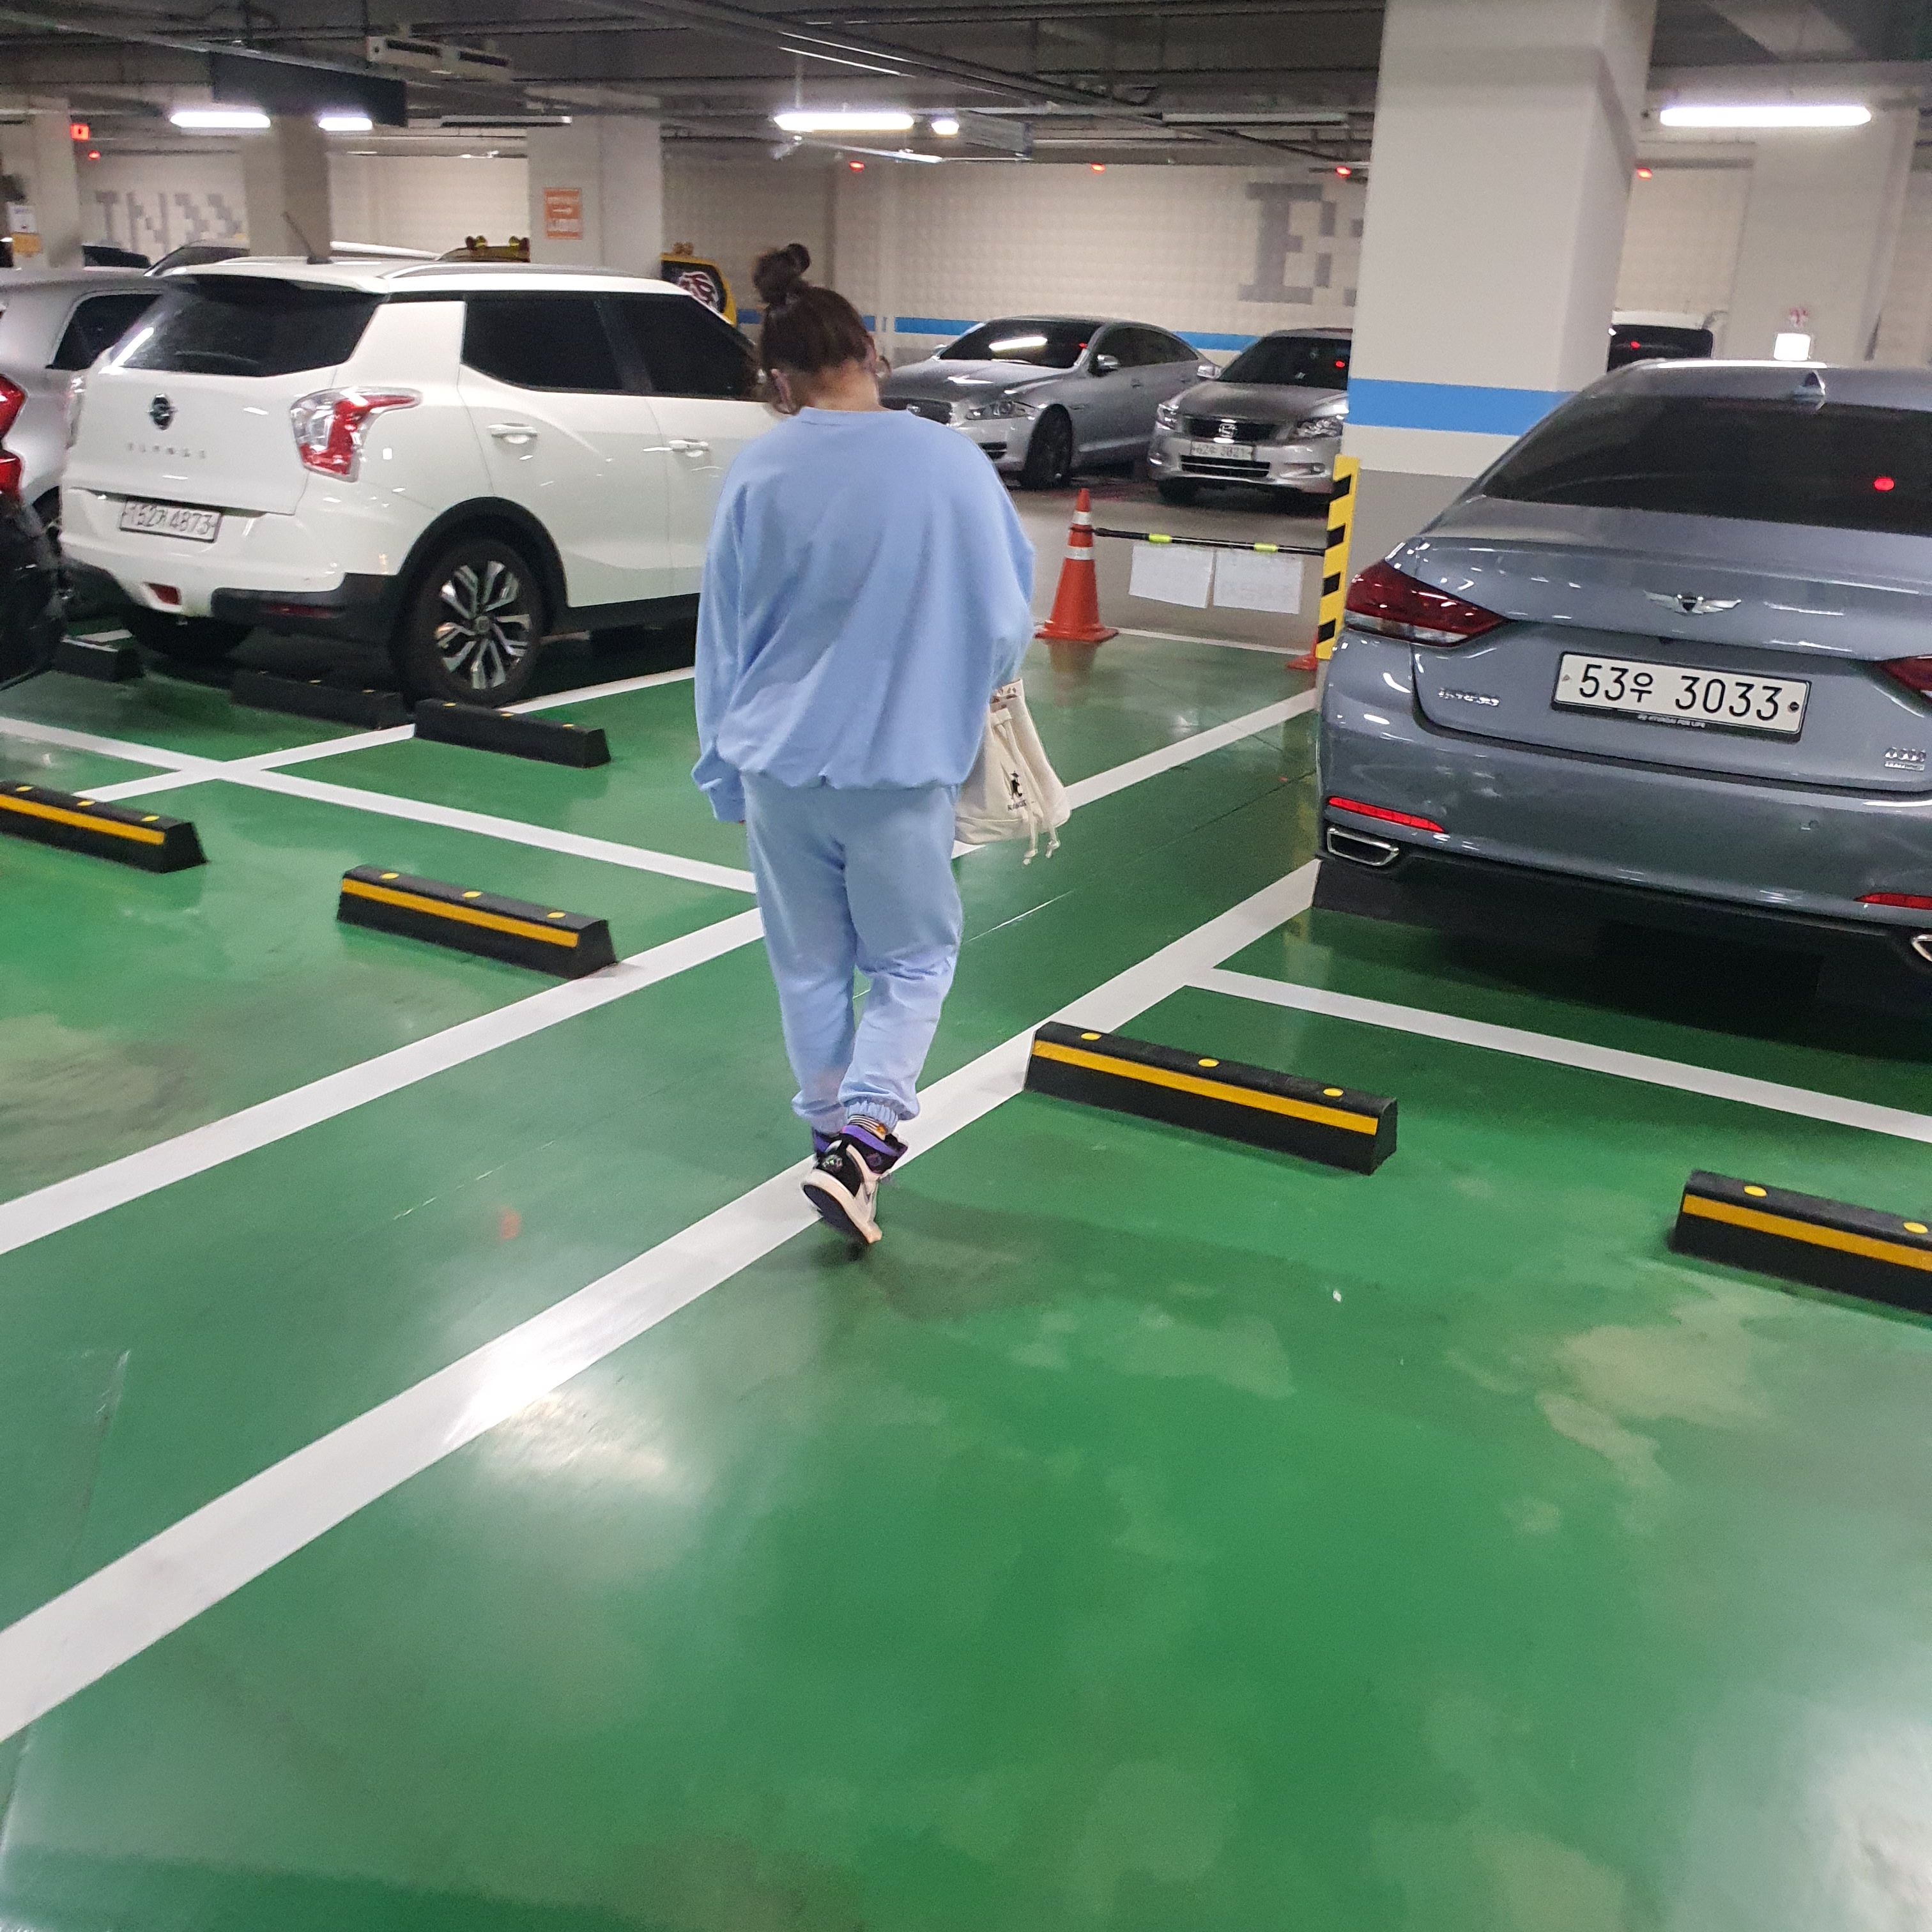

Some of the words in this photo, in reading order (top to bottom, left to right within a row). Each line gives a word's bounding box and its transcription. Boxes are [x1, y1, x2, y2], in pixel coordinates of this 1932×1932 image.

[169, 509, 213, 535] 4873
[1579, 664, 1653, 703] 53우
[1675, 675, 1783, 721] 3033
